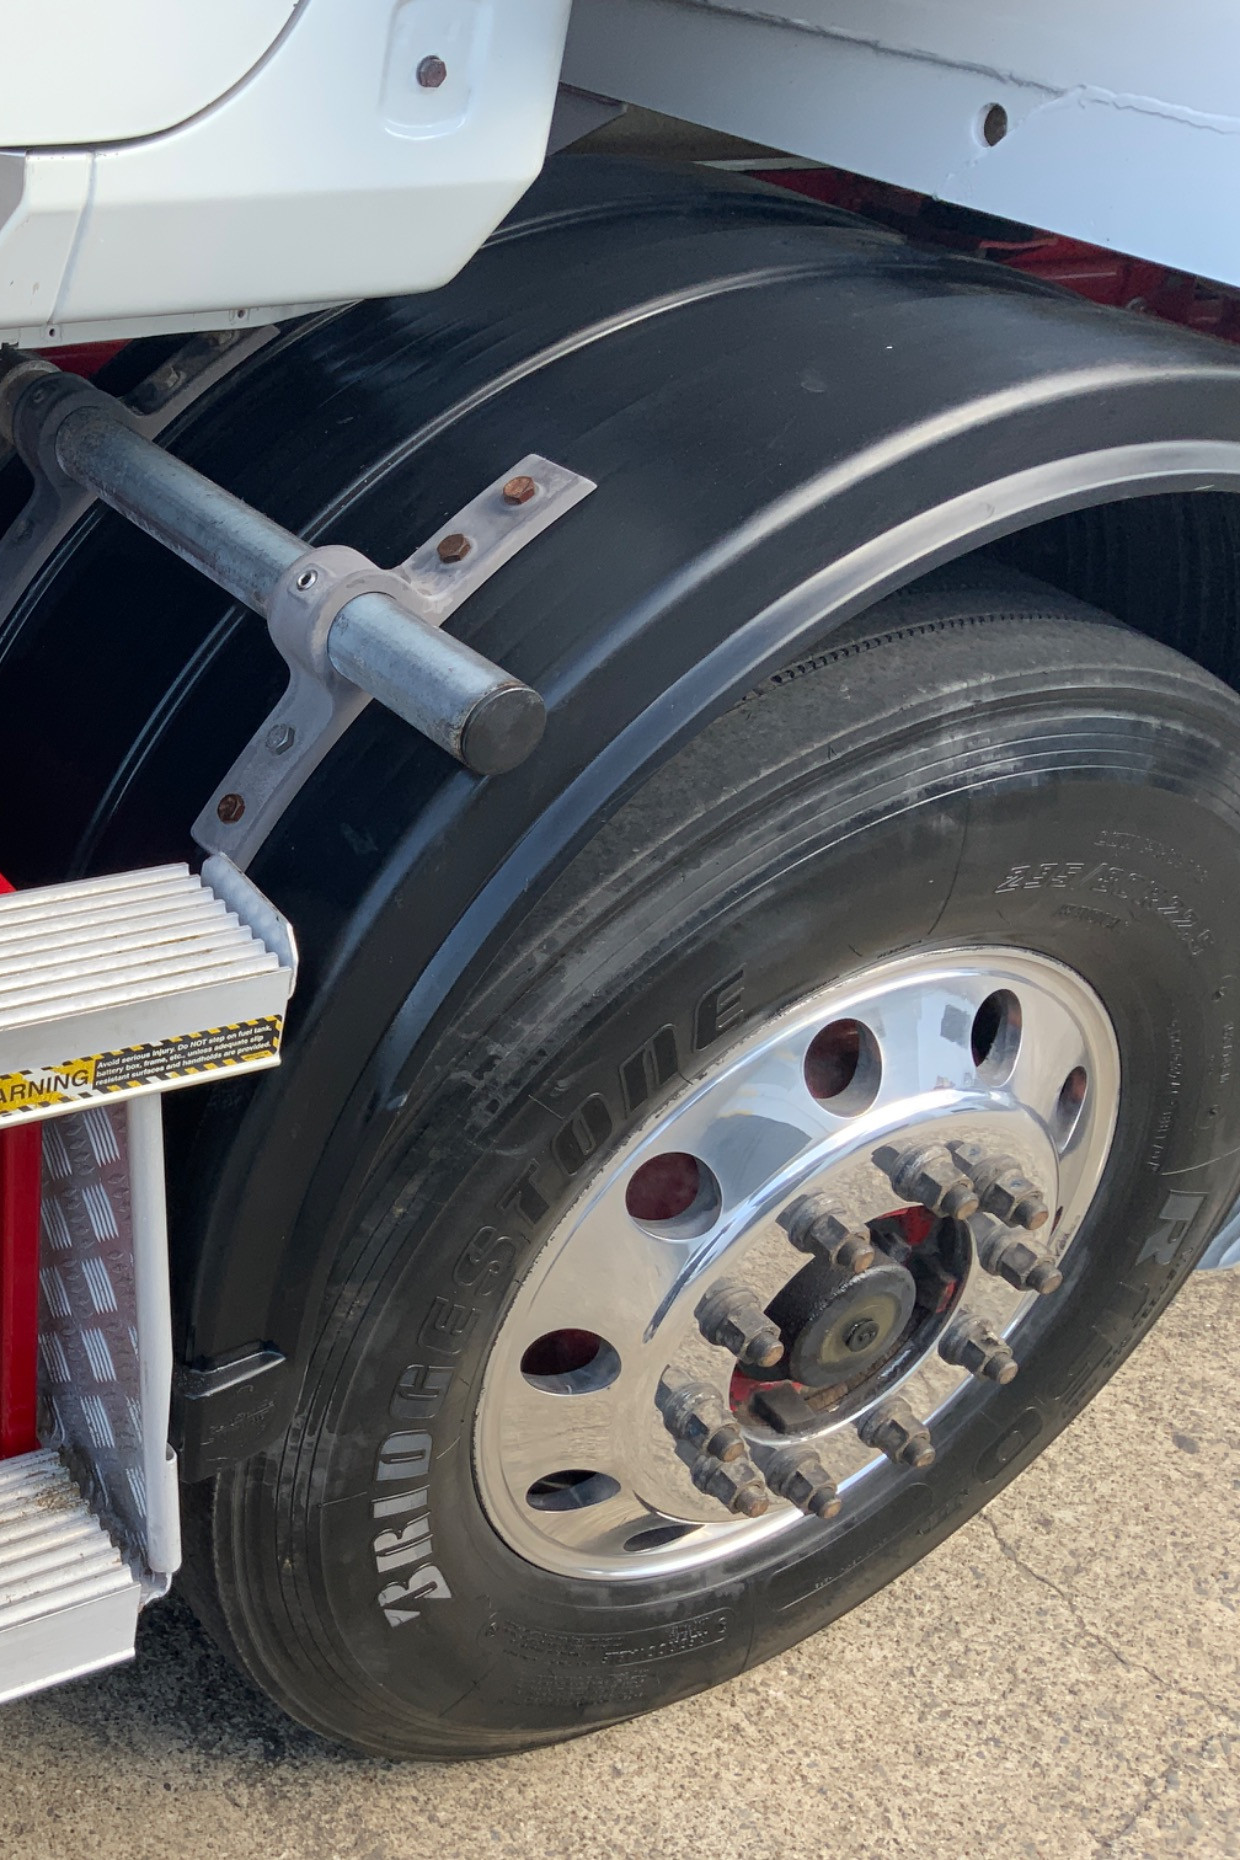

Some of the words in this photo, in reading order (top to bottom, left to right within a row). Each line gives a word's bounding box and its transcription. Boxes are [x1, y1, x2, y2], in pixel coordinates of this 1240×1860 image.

[95, 1073, 130, 1086] resistant
[131, 1066, 165, 1078] surfaces
[165, 1062, 181, 1070] and
[181, 1052, 222, 1066] handholds
[223, 1049, 236, 1057] are
[96, 1066, 124, 1078] battery
[187, 1046, 213, 1057] unless
[213, 1039, 248, 1052] adequate
[249, 1035, 264, 1043] slip
[97, 1058, 121, 1070] Avoid
[121, 1051, 151, 1064] serious
[177, 1043, 189, 1051] Do
[190, 1039, 208, 1048] NOT
[208, 1035, 226, 1045] step
[226, 1033, 237, 1041] on
[238, 1028, 253, 1038] fuel
[370, 969, 746, 1628] BRIDGESTONE
